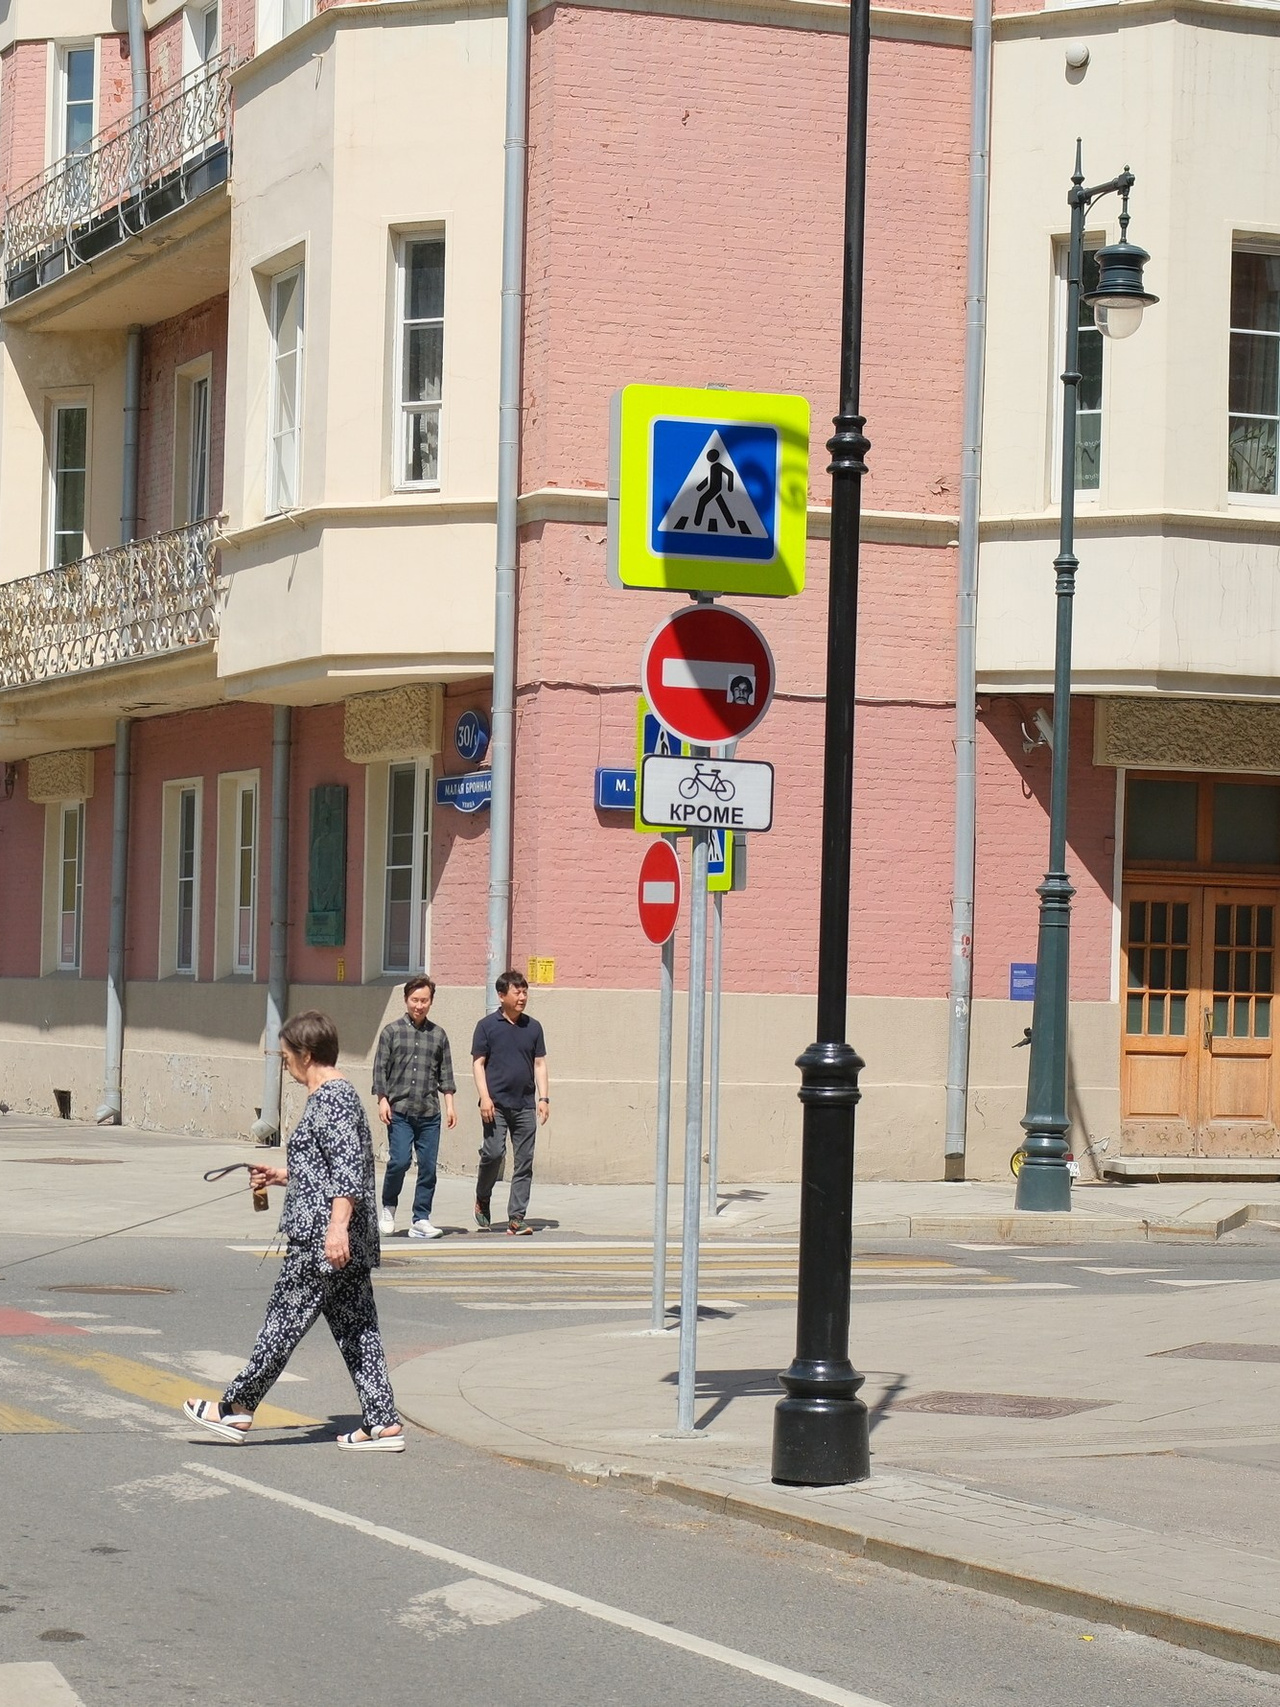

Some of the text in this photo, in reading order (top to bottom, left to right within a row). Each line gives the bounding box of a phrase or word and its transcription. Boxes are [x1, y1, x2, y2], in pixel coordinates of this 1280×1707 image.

[445, 780, 492, 796] МАЛАЯ БРОННАЯ
[615, 779, 631, 792] М.
[670, 803, 744, 825] КРОМЕ
